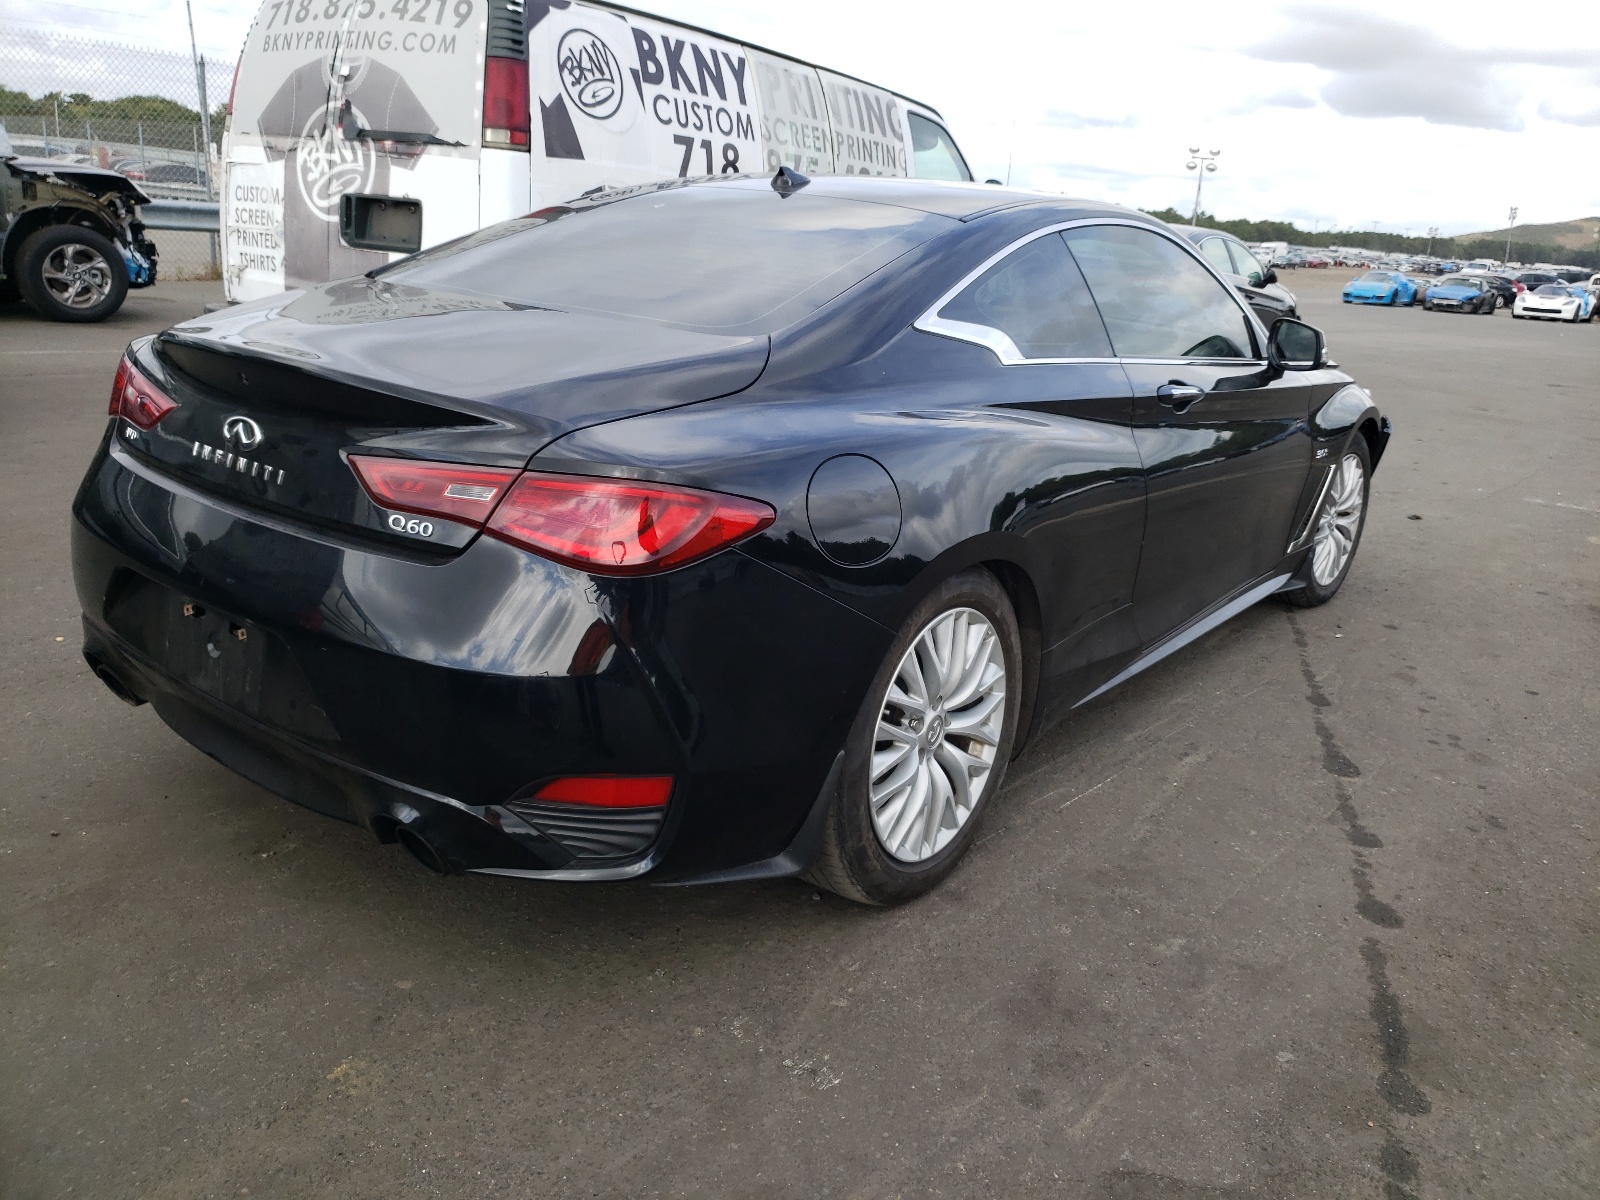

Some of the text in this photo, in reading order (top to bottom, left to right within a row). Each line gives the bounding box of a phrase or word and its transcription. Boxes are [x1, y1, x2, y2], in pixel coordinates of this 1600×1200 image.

[263, 30, 457, 54] BKNYPRINTING.COM
[631, 27, 747, 106] BKNY
[653, 94, 755, 142] CUSTOM
[758, 62, 904, 143] PRINTING
[673, 134, 739, 178] 718
[763, 114, 906, 172] SCREEN PRINTING
[235, 185, 280, 205] CUSTOM
[237, 229, 278, 249] PRINTED
[192, 441, 285, 485] INFINITI
[388, 514, 434, 537] Q60
